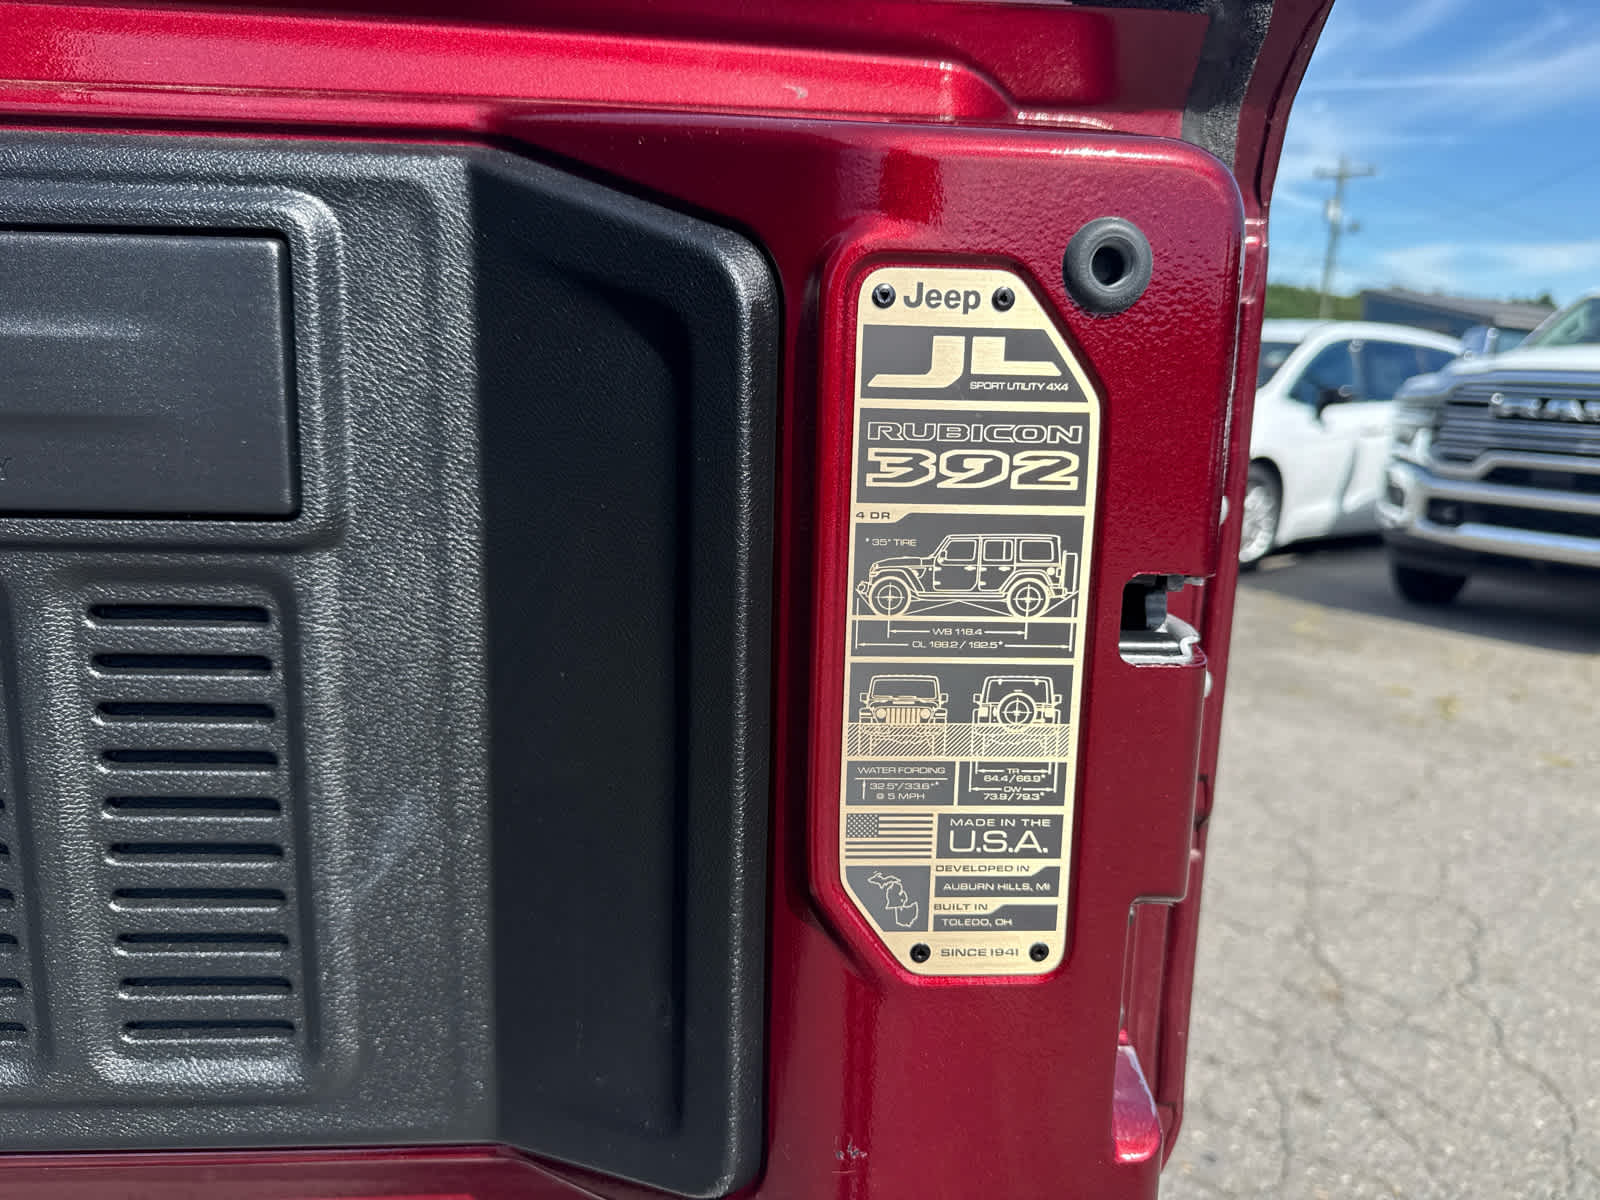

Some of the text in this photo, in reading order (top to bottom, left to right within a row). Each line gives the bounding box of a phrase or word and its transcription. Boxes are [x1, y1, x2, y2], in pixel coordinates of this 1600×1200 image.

[903, 282, 981, 314] Jeep
[867, 335, 1062, 388] JL
[969, 381, 1069, 392] SPORT UTILITY 4X4
[867, 421, 1083, 444] RUBICON
[865, 447, 1080, 491] 392
[855, 511, 890, 520] 4 DR
[893, 538, 917, 547] TIRE
[932, 628, 983, 636] WB 118.4
[911, 641, 927, 649] OL
[857, 766, 946, 775] WATER FORDING
[887, 792, 896, 800] 5
[898, 792, 926, 801] MPH
[949, 818, 1052, 828] MADE IN THE
[949, 830, 1049, 854] U.S.A.
[935, 865, 1014, 873] DEVELOPED
[943, 882, 1051, 892] AUBURN HILLS, MI
[933, 903, 971, 911] BUILT
[942, 918, 1013, 928] TOLEDO, OH
[940, 948, 1019, 957] SINCE 1941
